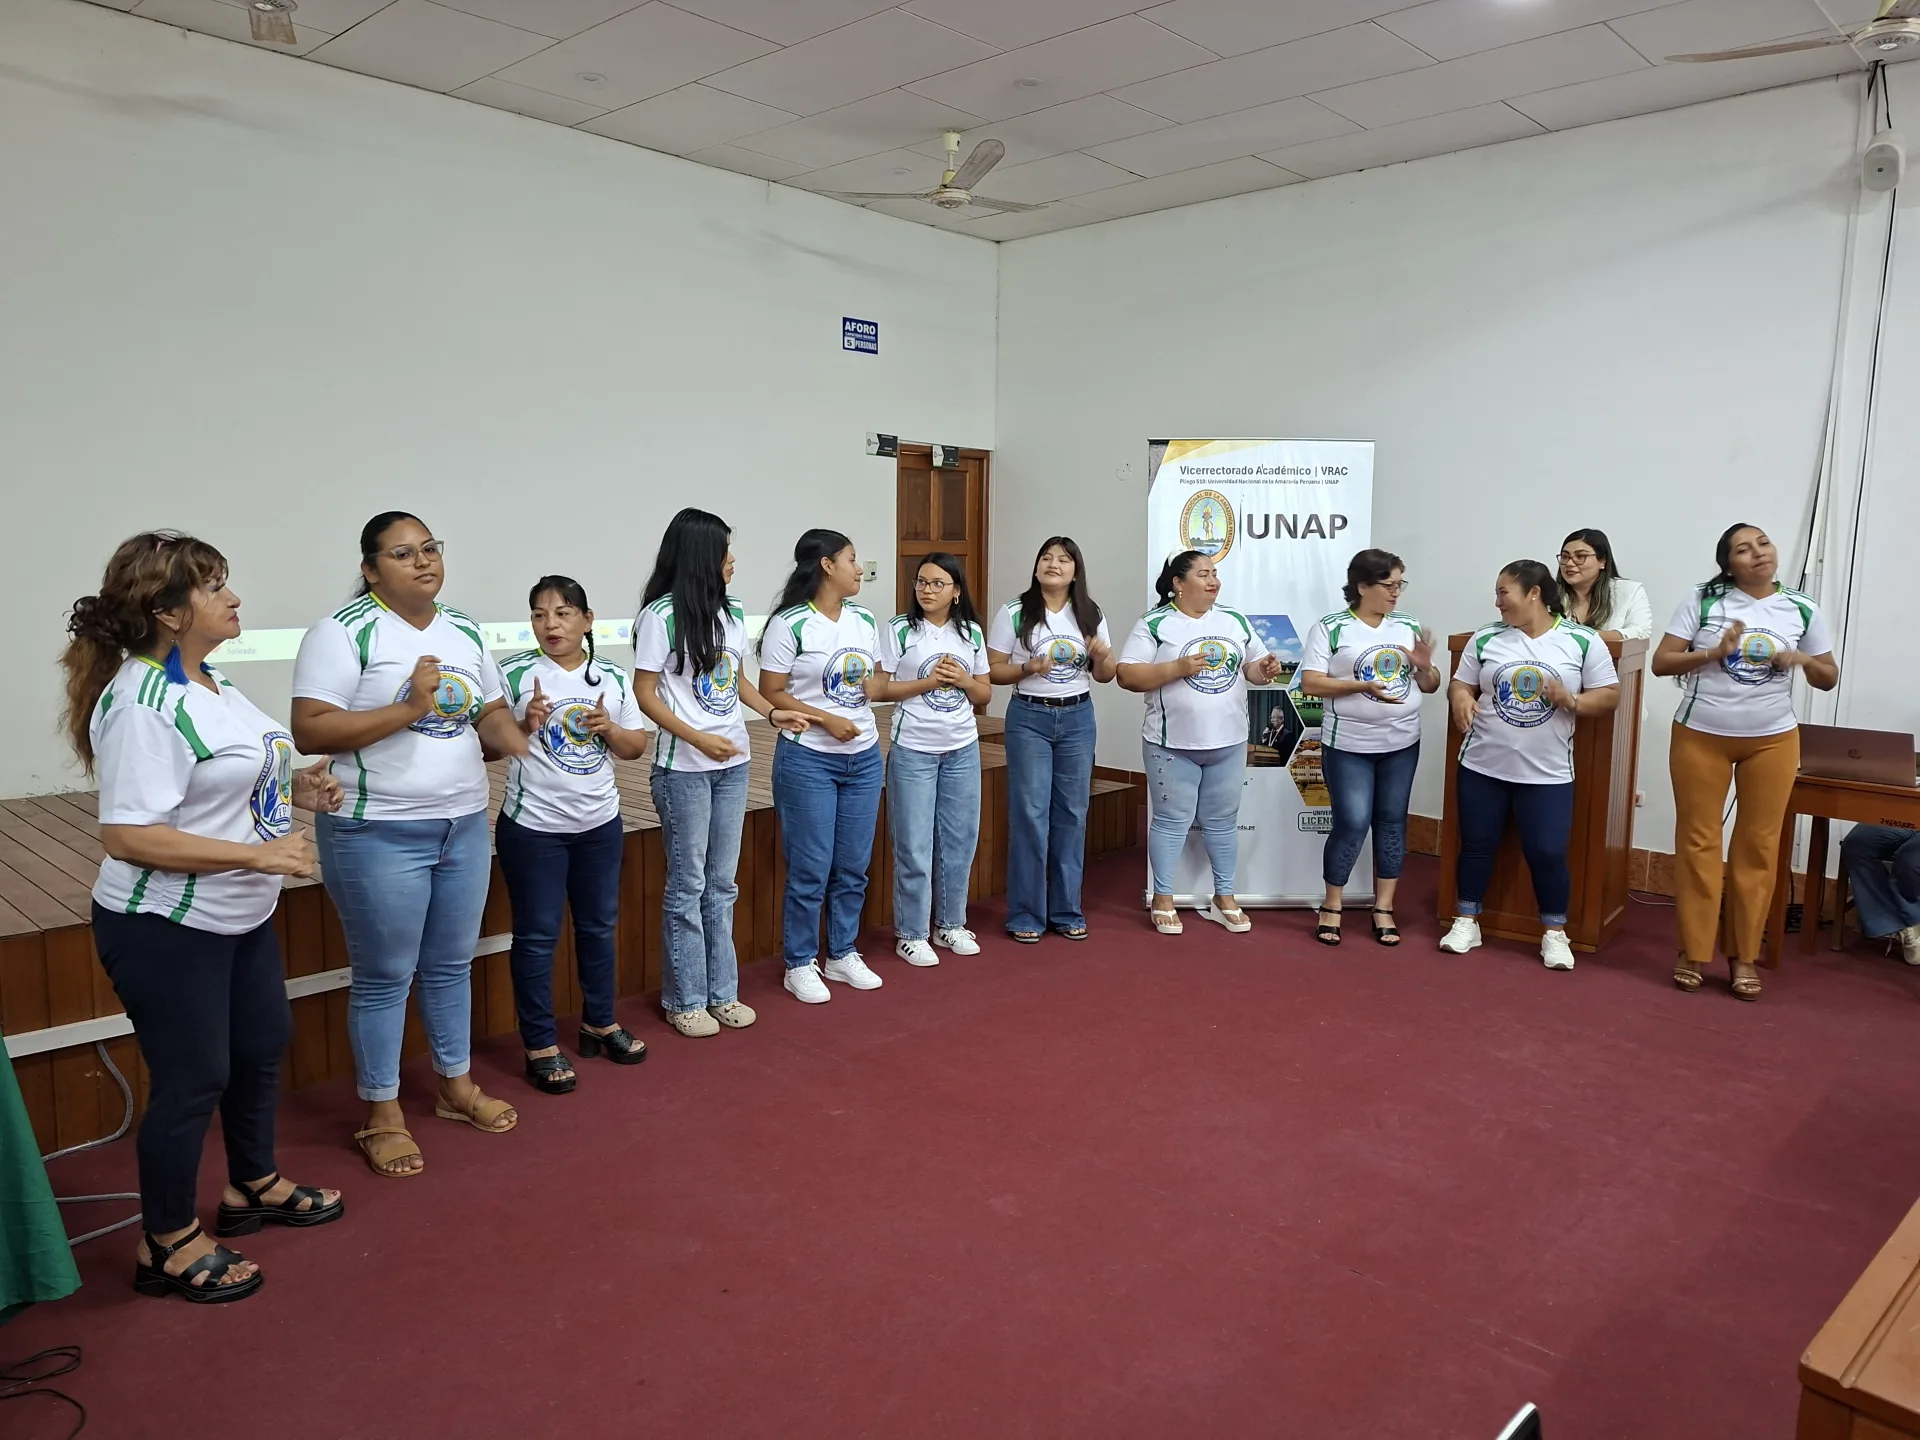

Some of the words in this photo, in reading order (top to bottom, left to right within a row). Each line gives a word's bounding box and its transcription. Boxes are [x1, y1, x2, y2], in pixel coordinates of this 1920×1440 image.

[845, 321, 876, 335] AFORO
[1180, 466, 1254, 475] Vicerrectorado
[1256, 466, 1311, 476] Académico
[1320, 466, 1348, 476] VRAC
[1184, 494, 1203, 516] NACIONAL
[1247, 514, 1348, 539] UNAP
